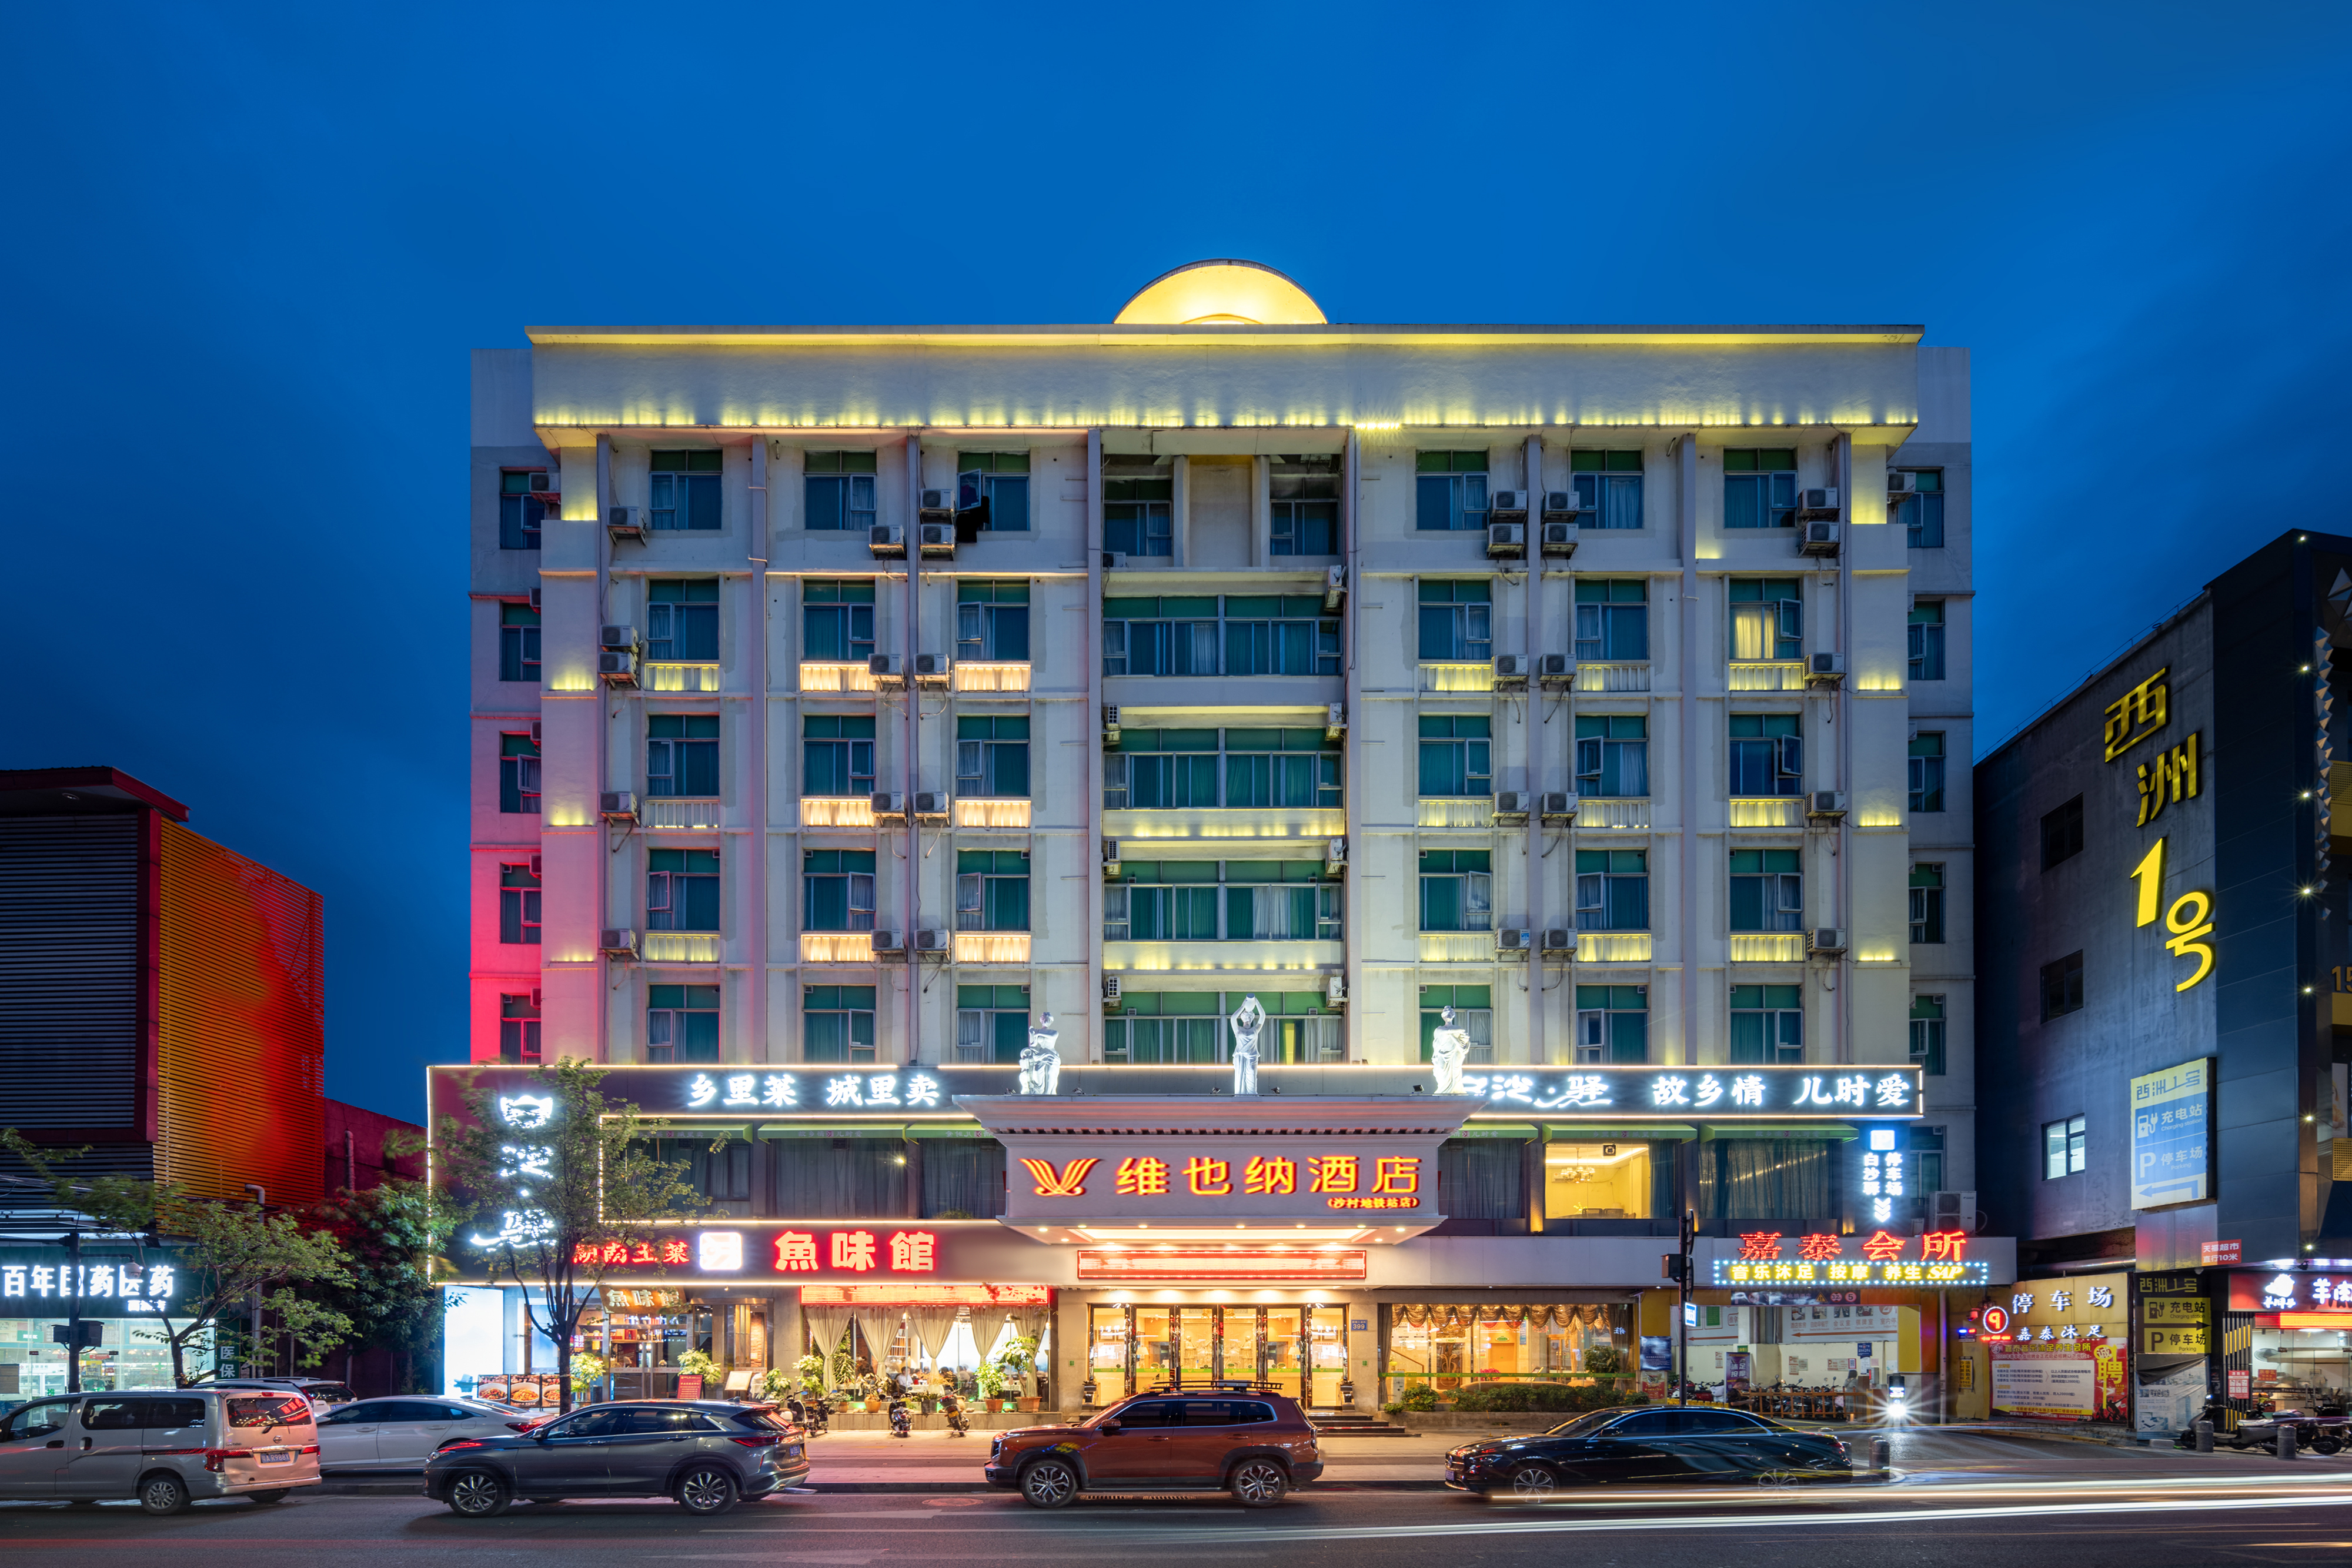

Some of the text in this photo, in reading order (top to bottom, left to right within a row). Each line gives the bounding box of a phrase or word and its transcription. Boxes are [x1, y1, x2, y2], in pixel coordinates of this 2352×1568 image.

[2104, 666, 2215, 992] 西洲1号
[687, 1074, 940, 1106] 乡里菜 城里卖
[1652, 1074, 1910, 1106] 故乡情 儿时爱
[2137, 1069, 2200, 1101] 西洲1号
[2161, 1103, 2203, 1125] 充电站
[2160, 1118, 2203, 1132] Charging station
[2140, 1152, 2156, 1178] P
[2160, 1146, 2203, 1166] 停车场
[1115, 1156, 1422, 1196] 维也纳酒店
[1885, 1152, 1902, 1195] 停车场
[774, 1231, 934, 1271] 魚味館
[1738, 1231, 1967, 1262] 嘉泰会所
[2203, 1242, 2239, 1253] 天福超市
[2203, 1253, 2239, 1263] 直行10米
[1732, 1264, 1963, 1280] 音乐沐足 按摩 养生 SAP
[2139, 1278, 2197, 1292] 西洲1号
[606, 1289, 680, 1308] 魚味館
[2012, 1286, 2114, 1315] 停车场
[2170, 1301, 2206, 1313] 充电站
[2016, 1324, 2107, 1341] 嘉泰沐足
[2151, 1332, 2164, 1352] P
[2169, 1333, 2206, 1345] 停车场
[2004, 1343, 2092, 1352] 嘉泰音乐沐足养生会所
[220, 1346, 235, 1378] 医保
